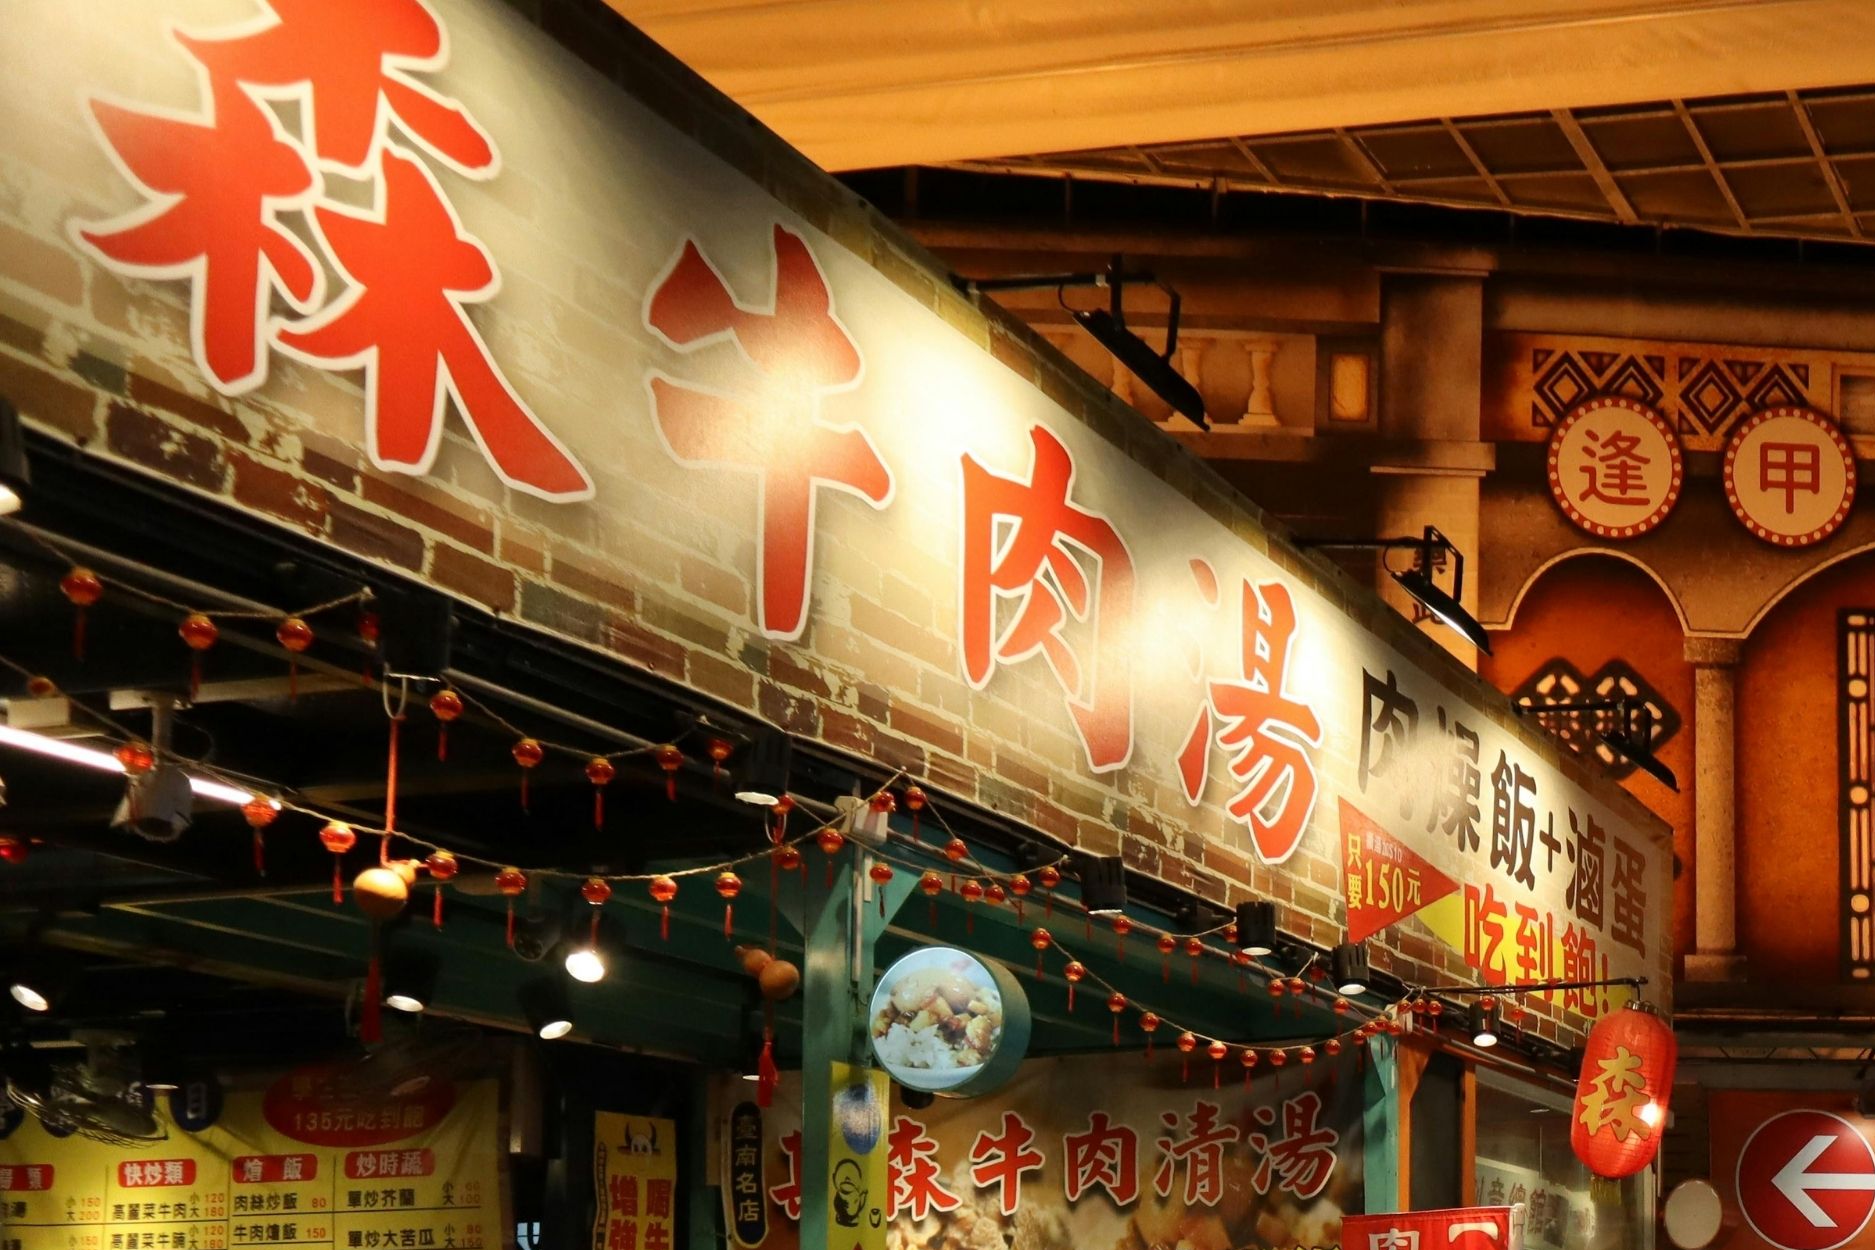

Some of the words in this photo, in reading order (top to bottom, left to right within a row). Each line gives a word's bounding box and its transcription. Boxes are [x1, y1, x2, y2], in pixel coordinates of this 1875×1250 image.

[1358, 666, 1648, 960] 肉燥飯+滷蛋
[1347, 832, 1362, 911] 只要
[1366, 858, 1421, 913] 150元
[1463, 883, 1610, 1020] 吃到飽!
[1579, 1046, 1651, 1142] 森
[124, 1161, 183, 1186] 快炒類
[348, 1229, 435, 1247] 單炒大苦瓜
